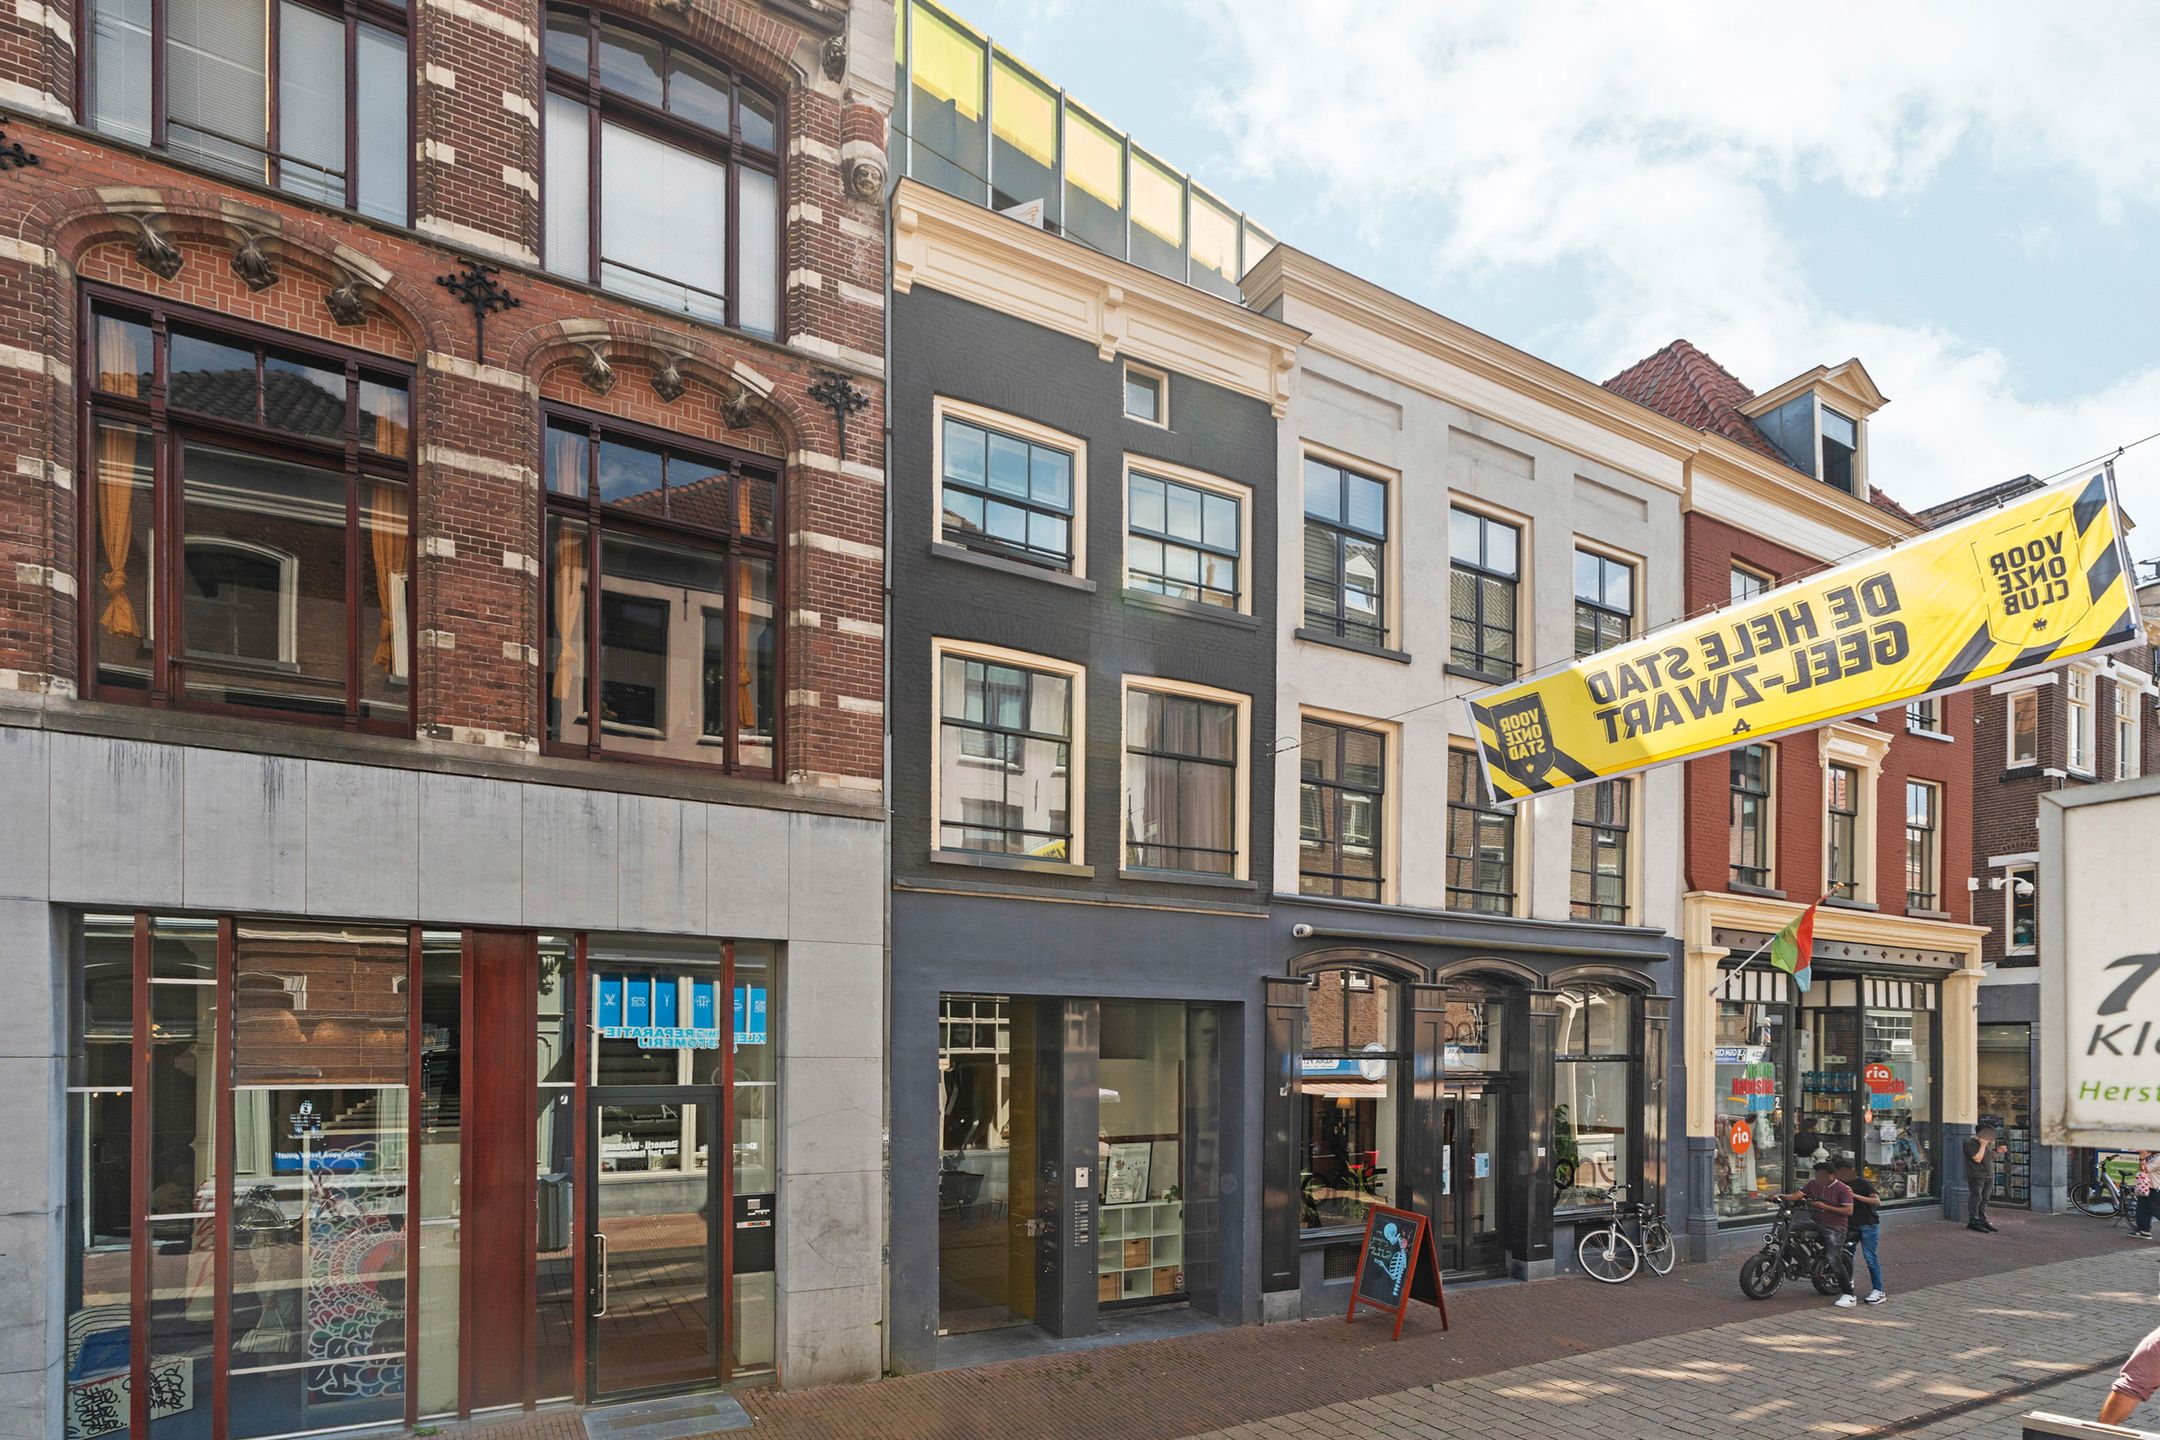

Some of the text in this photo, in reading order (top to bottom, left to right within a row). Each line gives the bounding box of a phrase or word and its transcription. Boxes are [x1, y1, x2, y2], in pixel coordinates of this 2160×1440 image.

[2086, 1020, 2160, 1057] Kl
[1866, 1066, 1889, 1078] ria
[1732, 1127, 1749, 1145] ria
